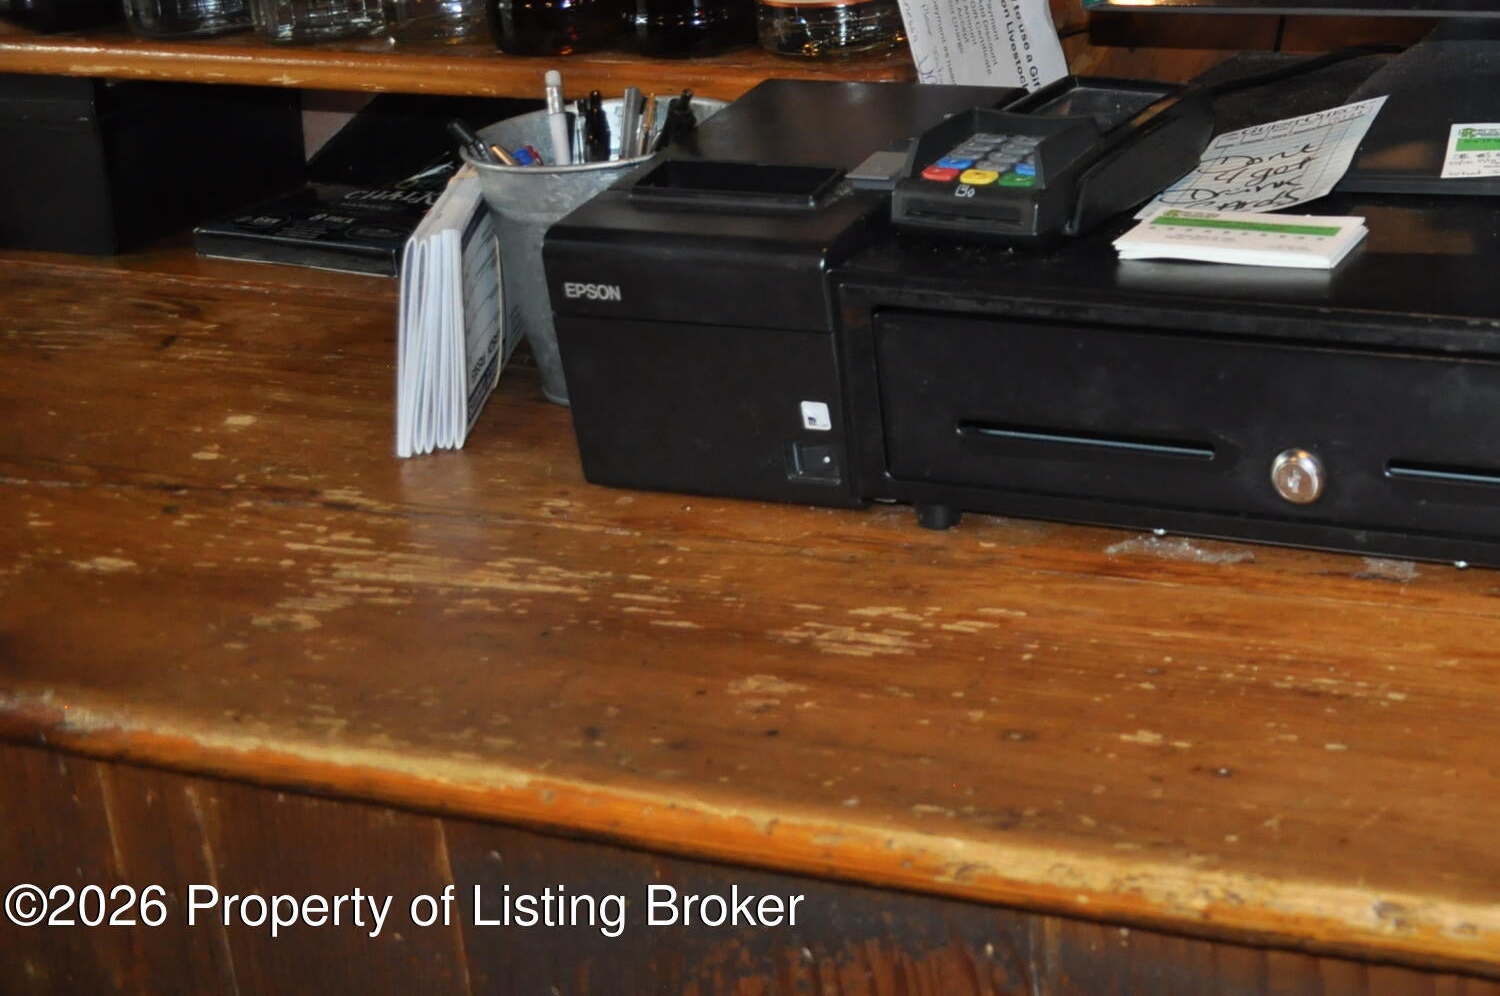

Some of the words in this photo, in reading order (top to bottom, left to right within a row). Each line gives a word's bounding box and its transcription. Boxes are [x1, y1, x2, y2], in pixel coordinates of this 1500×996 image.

[1013, 4, 1022, 19] to
[1018, 24, 1030, 51] use
[564, 281, 622, 302] EPSON
